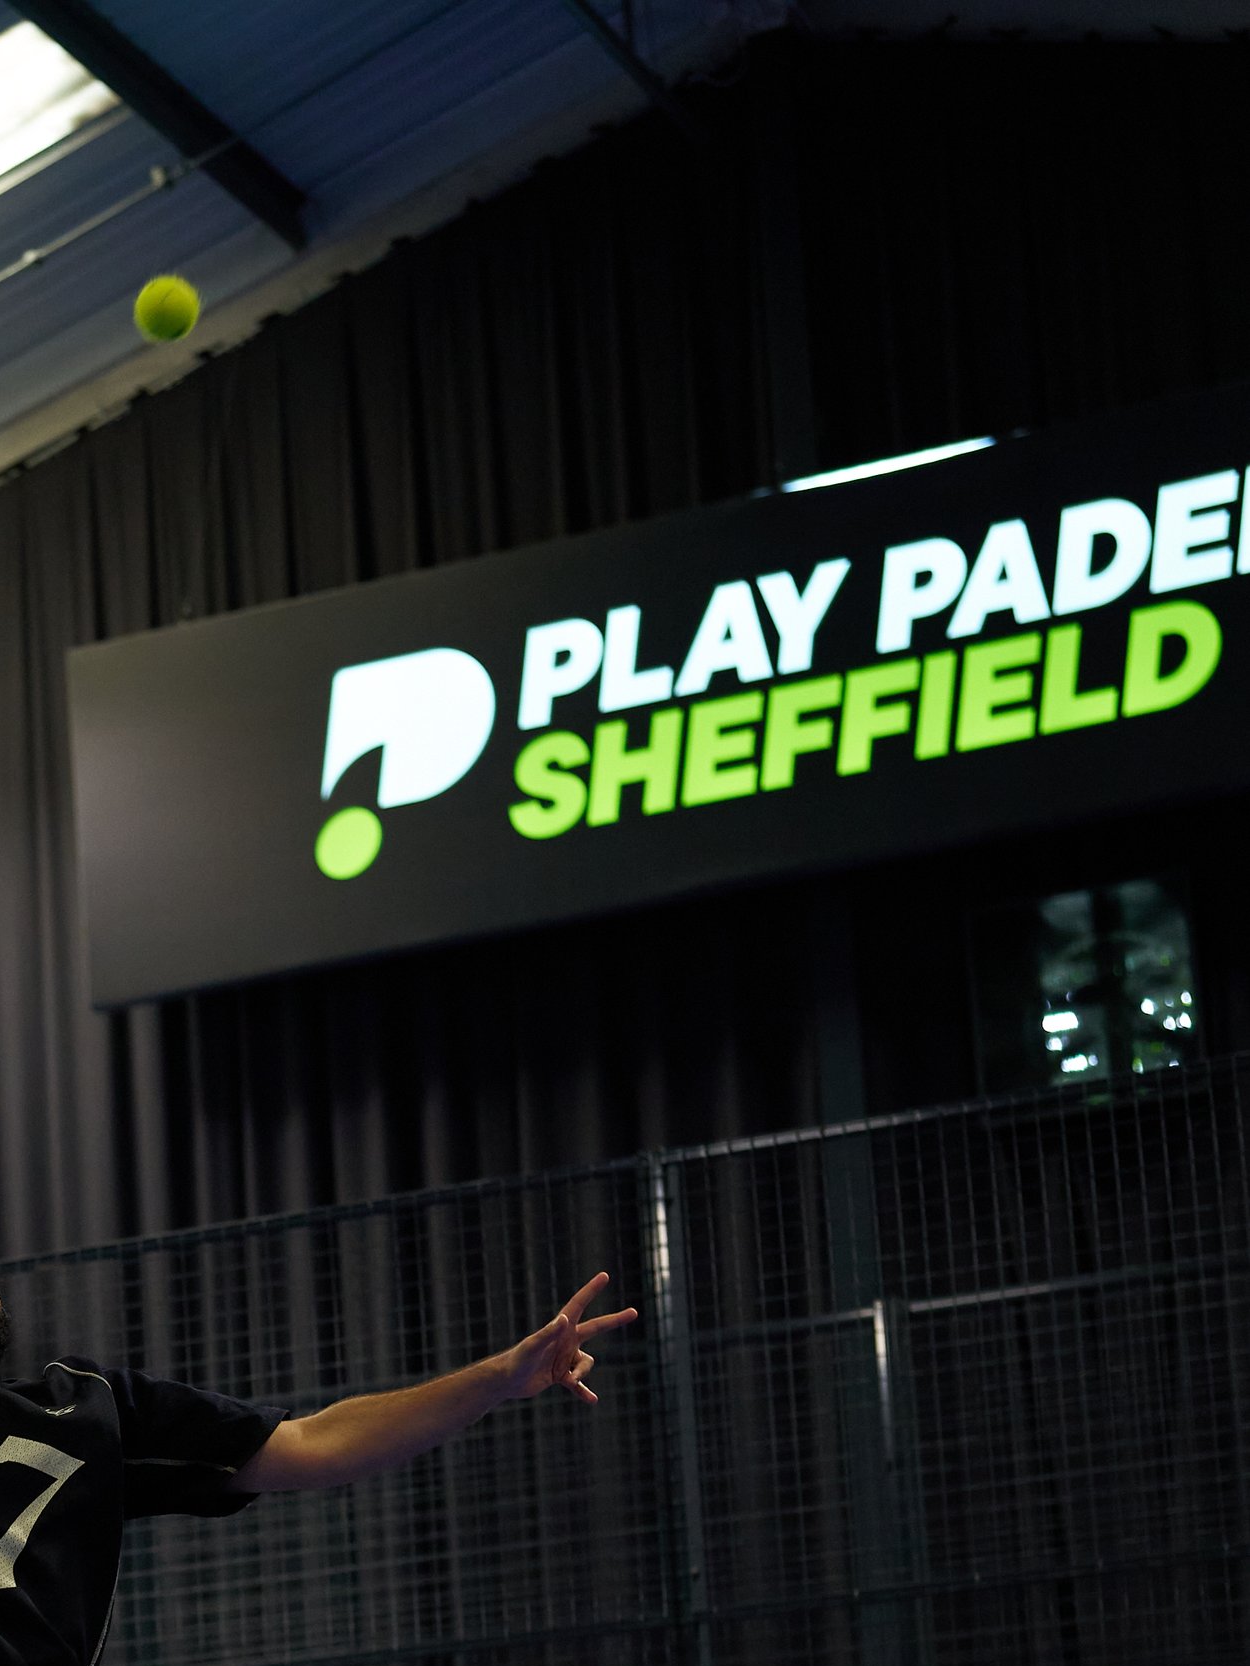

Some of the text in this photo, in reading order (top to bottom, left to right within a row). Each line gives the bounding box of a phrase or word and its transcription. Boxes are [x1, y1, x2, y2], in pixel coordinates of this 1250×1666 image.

[507, 600, 1223, 840] SHEFFIELD
[517, 463, 1250, 731] PLAY PADE
